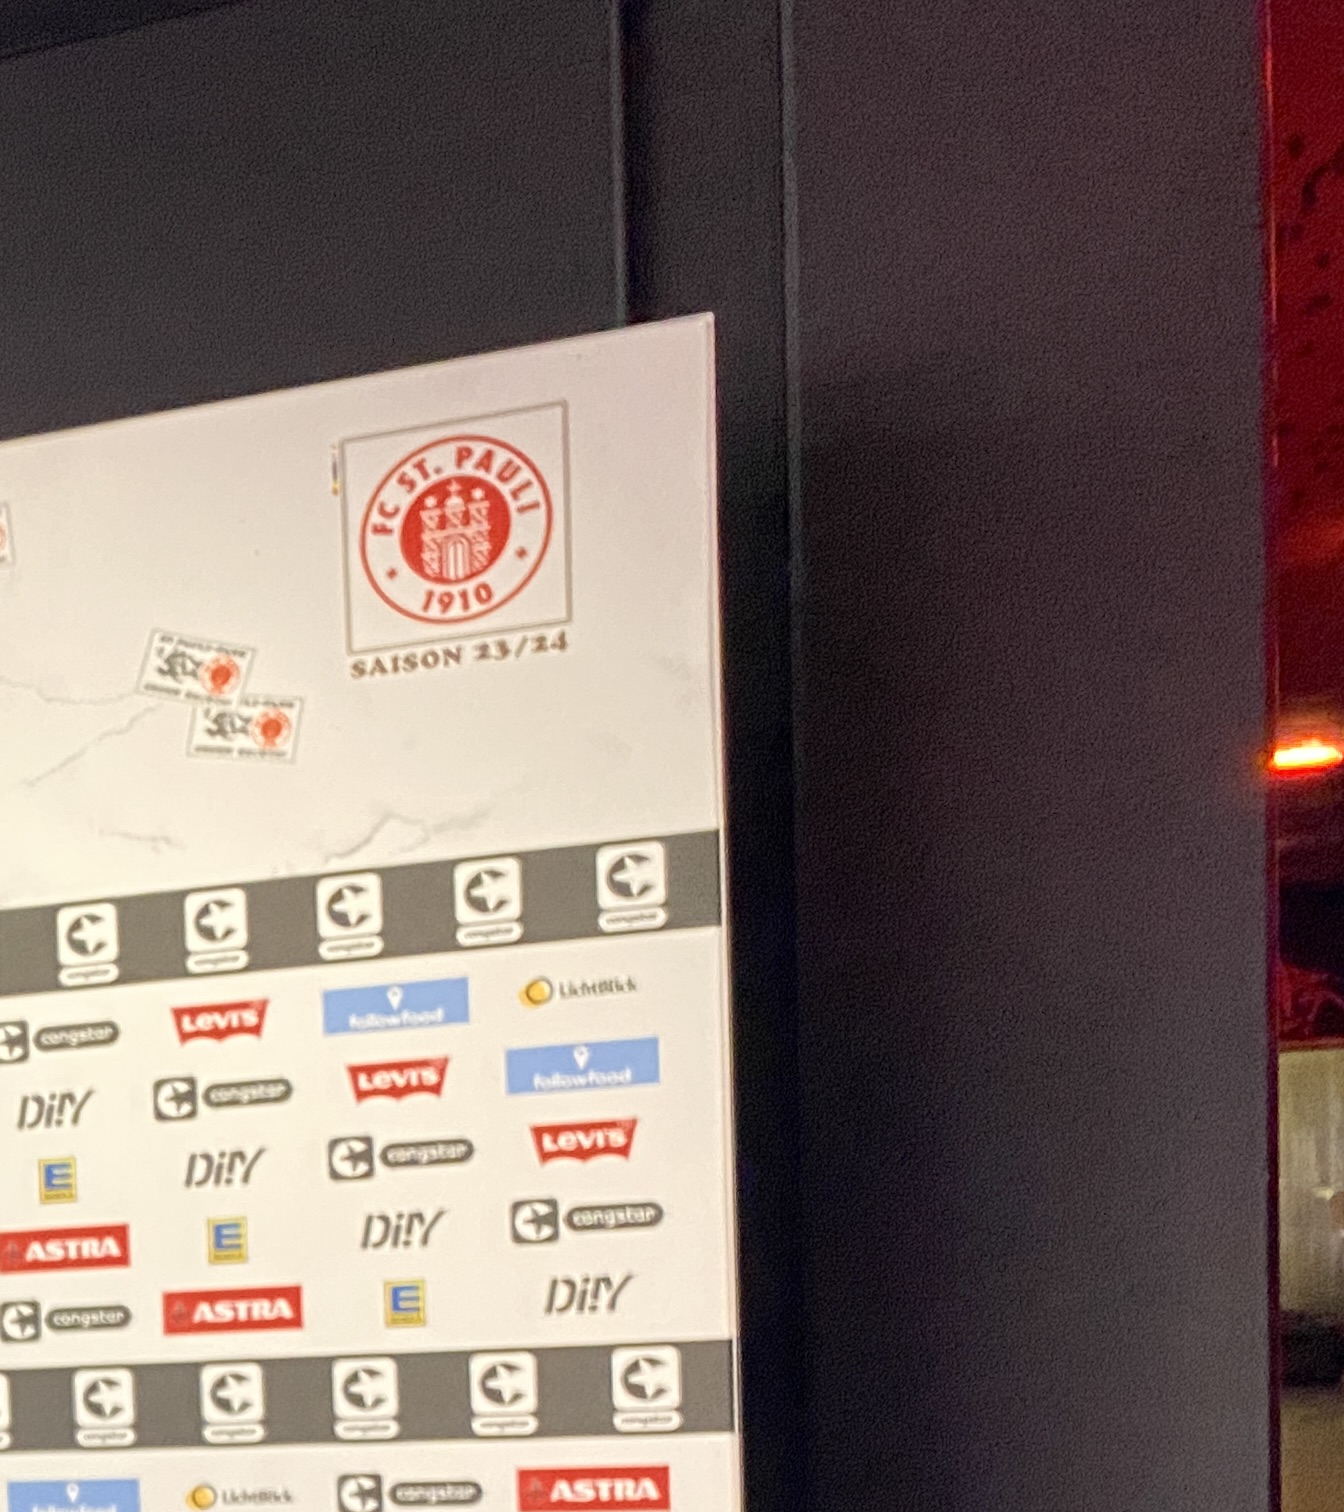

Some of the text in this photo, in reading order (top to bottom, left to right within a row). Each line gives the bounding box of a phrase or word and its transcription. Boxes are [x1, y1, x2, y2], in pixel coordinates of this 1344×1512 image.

[372, 446, 541, 536] FC ST. PAULI
[421, 583, 494, 613] 1910
[351, 630, 567, 678] SAISON 23/24
[27, 1238, 119, 1260] ASTRA
[195, 1299, 292, 1321] ASTRA
[552, 1479, 658, 1501] ASTRA
